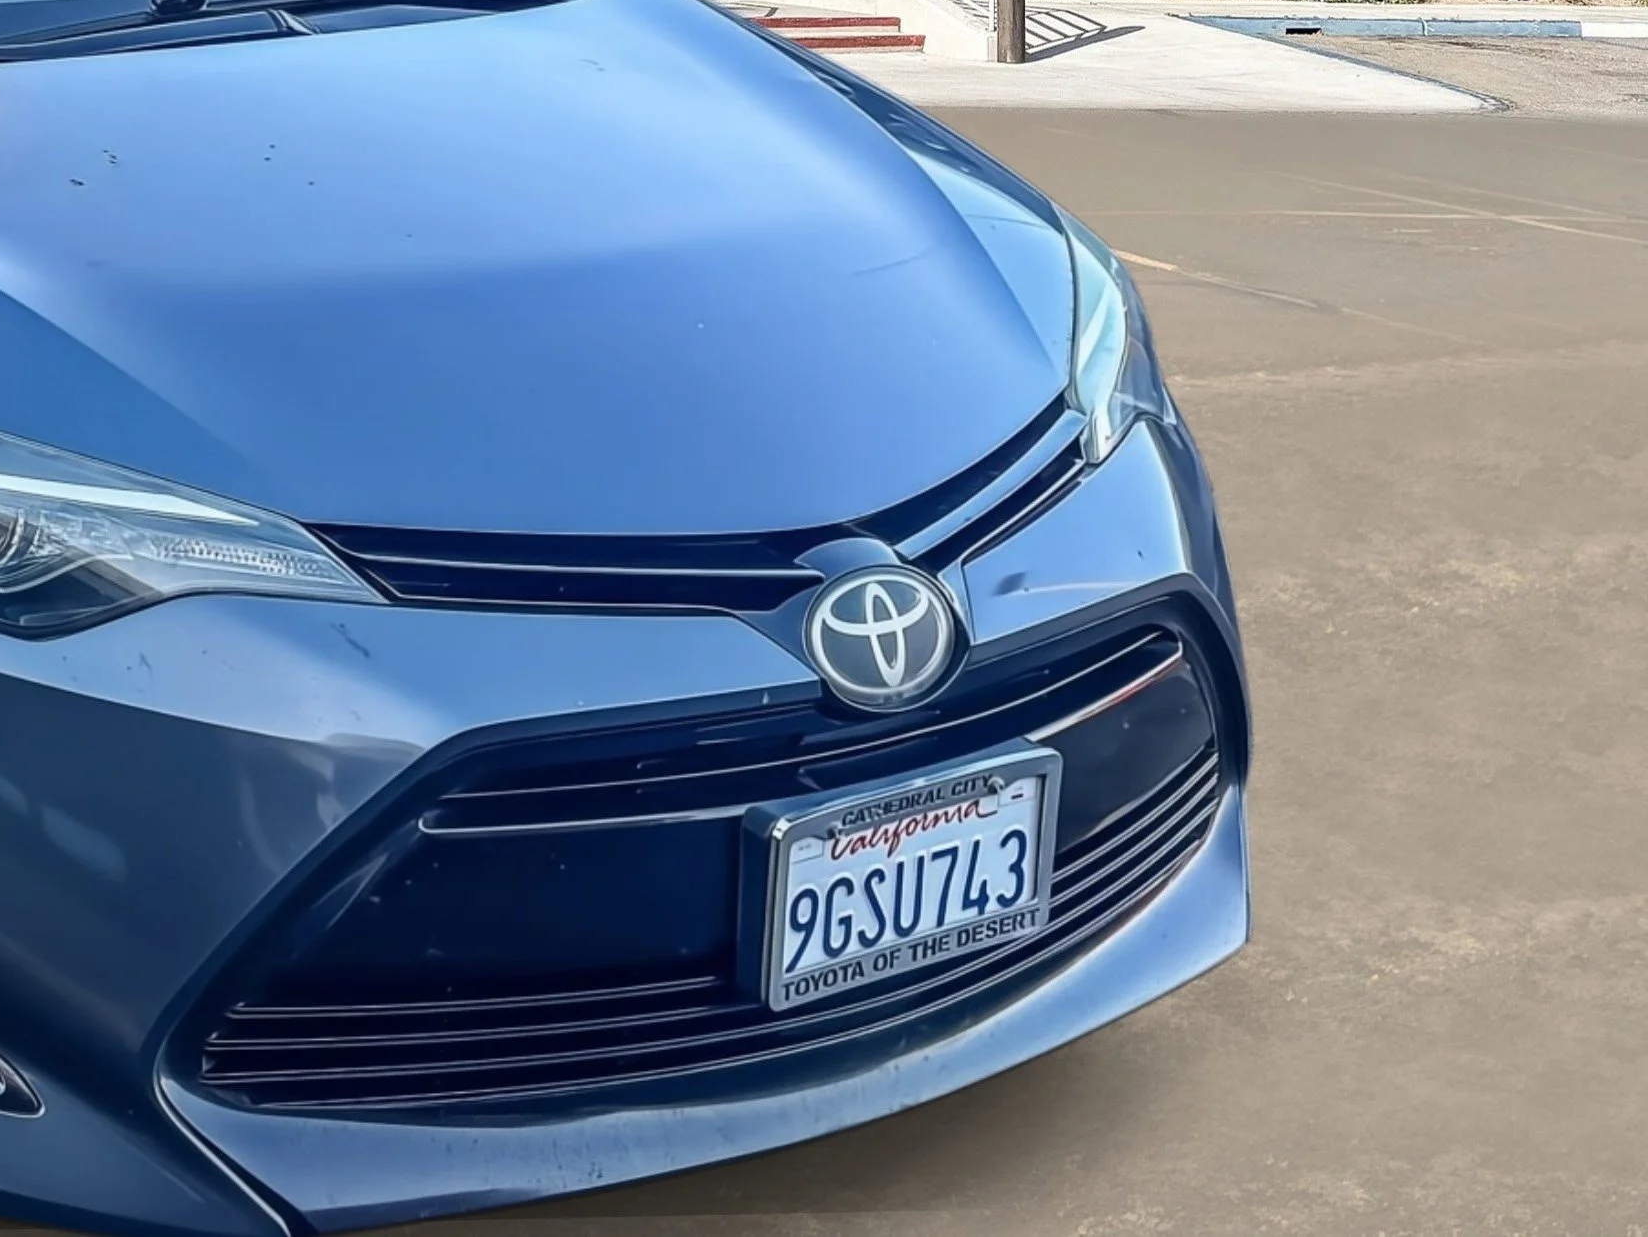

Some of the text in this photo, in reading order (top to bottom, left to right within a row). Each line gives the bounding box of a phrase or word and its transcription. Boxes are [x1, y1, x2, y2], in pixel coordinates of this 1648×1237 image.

[830, 797, 999, 861] California
[841, 773, 994, 828] CATHEDRAL CITY
[784, 828, 1028, 975] 9GSU743
[781, 908, 1041, 1002] TOYOTA OF THE DESERT
